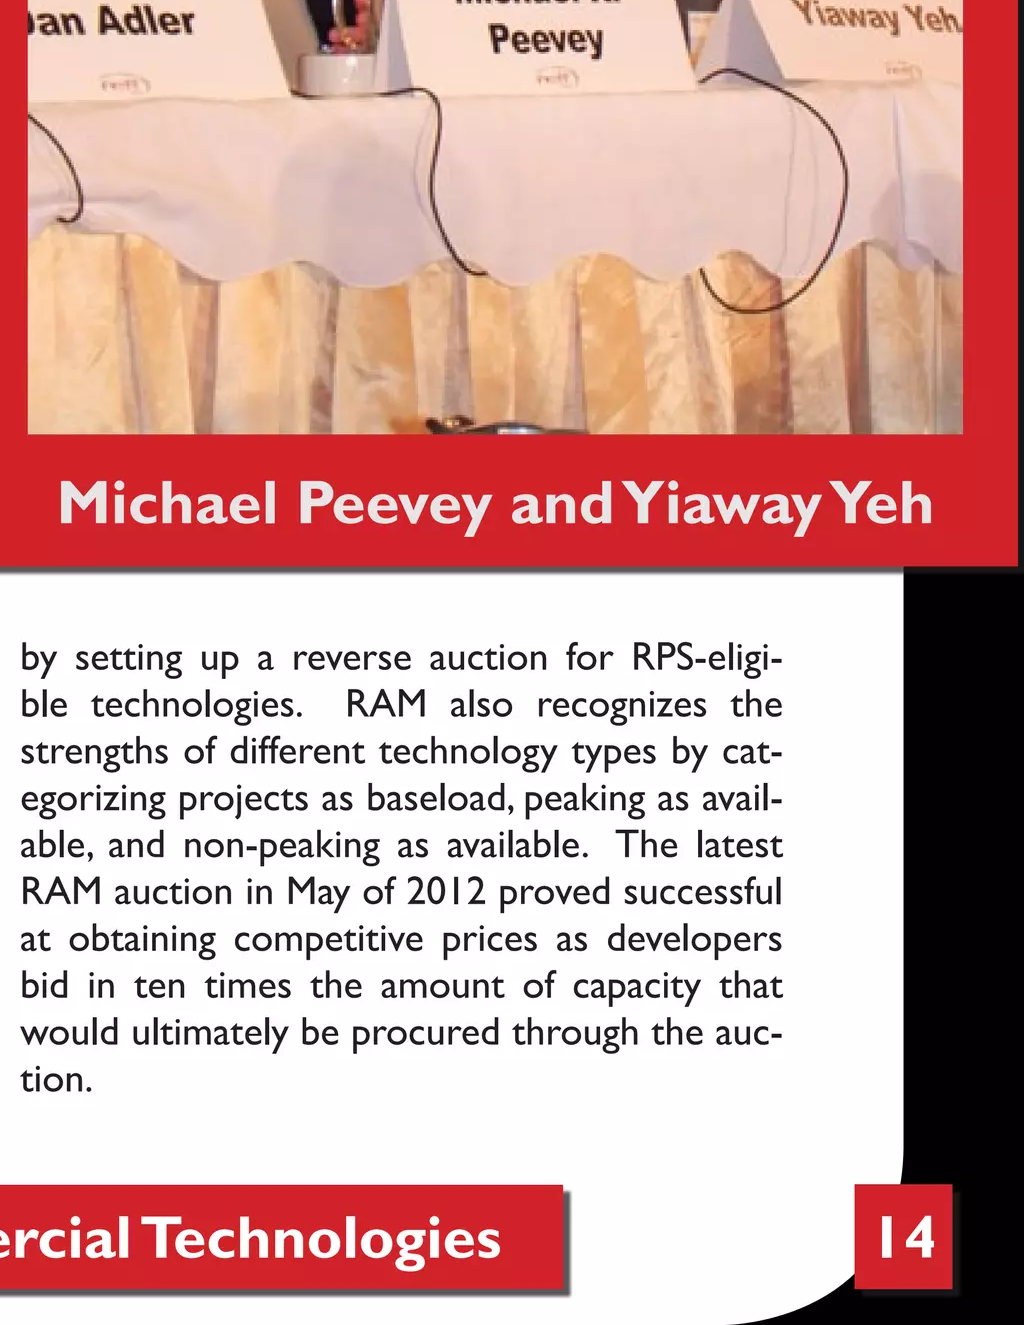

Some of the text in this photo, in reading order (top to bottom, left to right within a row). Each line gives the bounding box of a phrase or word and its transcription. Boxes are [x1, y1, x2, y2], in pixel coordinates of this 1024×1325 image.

[97, 3, 195, 36] Adler
[487, 23, 603, 60] Peevey
[61, 480, 932, 537] Michael Peevey and Yiaway Yeh
[21, 735, 783, 774] strengths of different technology types by cat-
[22, 875, 782, 914] RAM auction in May of 2012 proved successful
[21, 969, 784, 1008] bid in ten times the amount of capacity that
[20, 1065, 92, 1093] tion.
[141, 1216, 500, 1272] Technologies
[882, 1216, 934, 1258] 14
